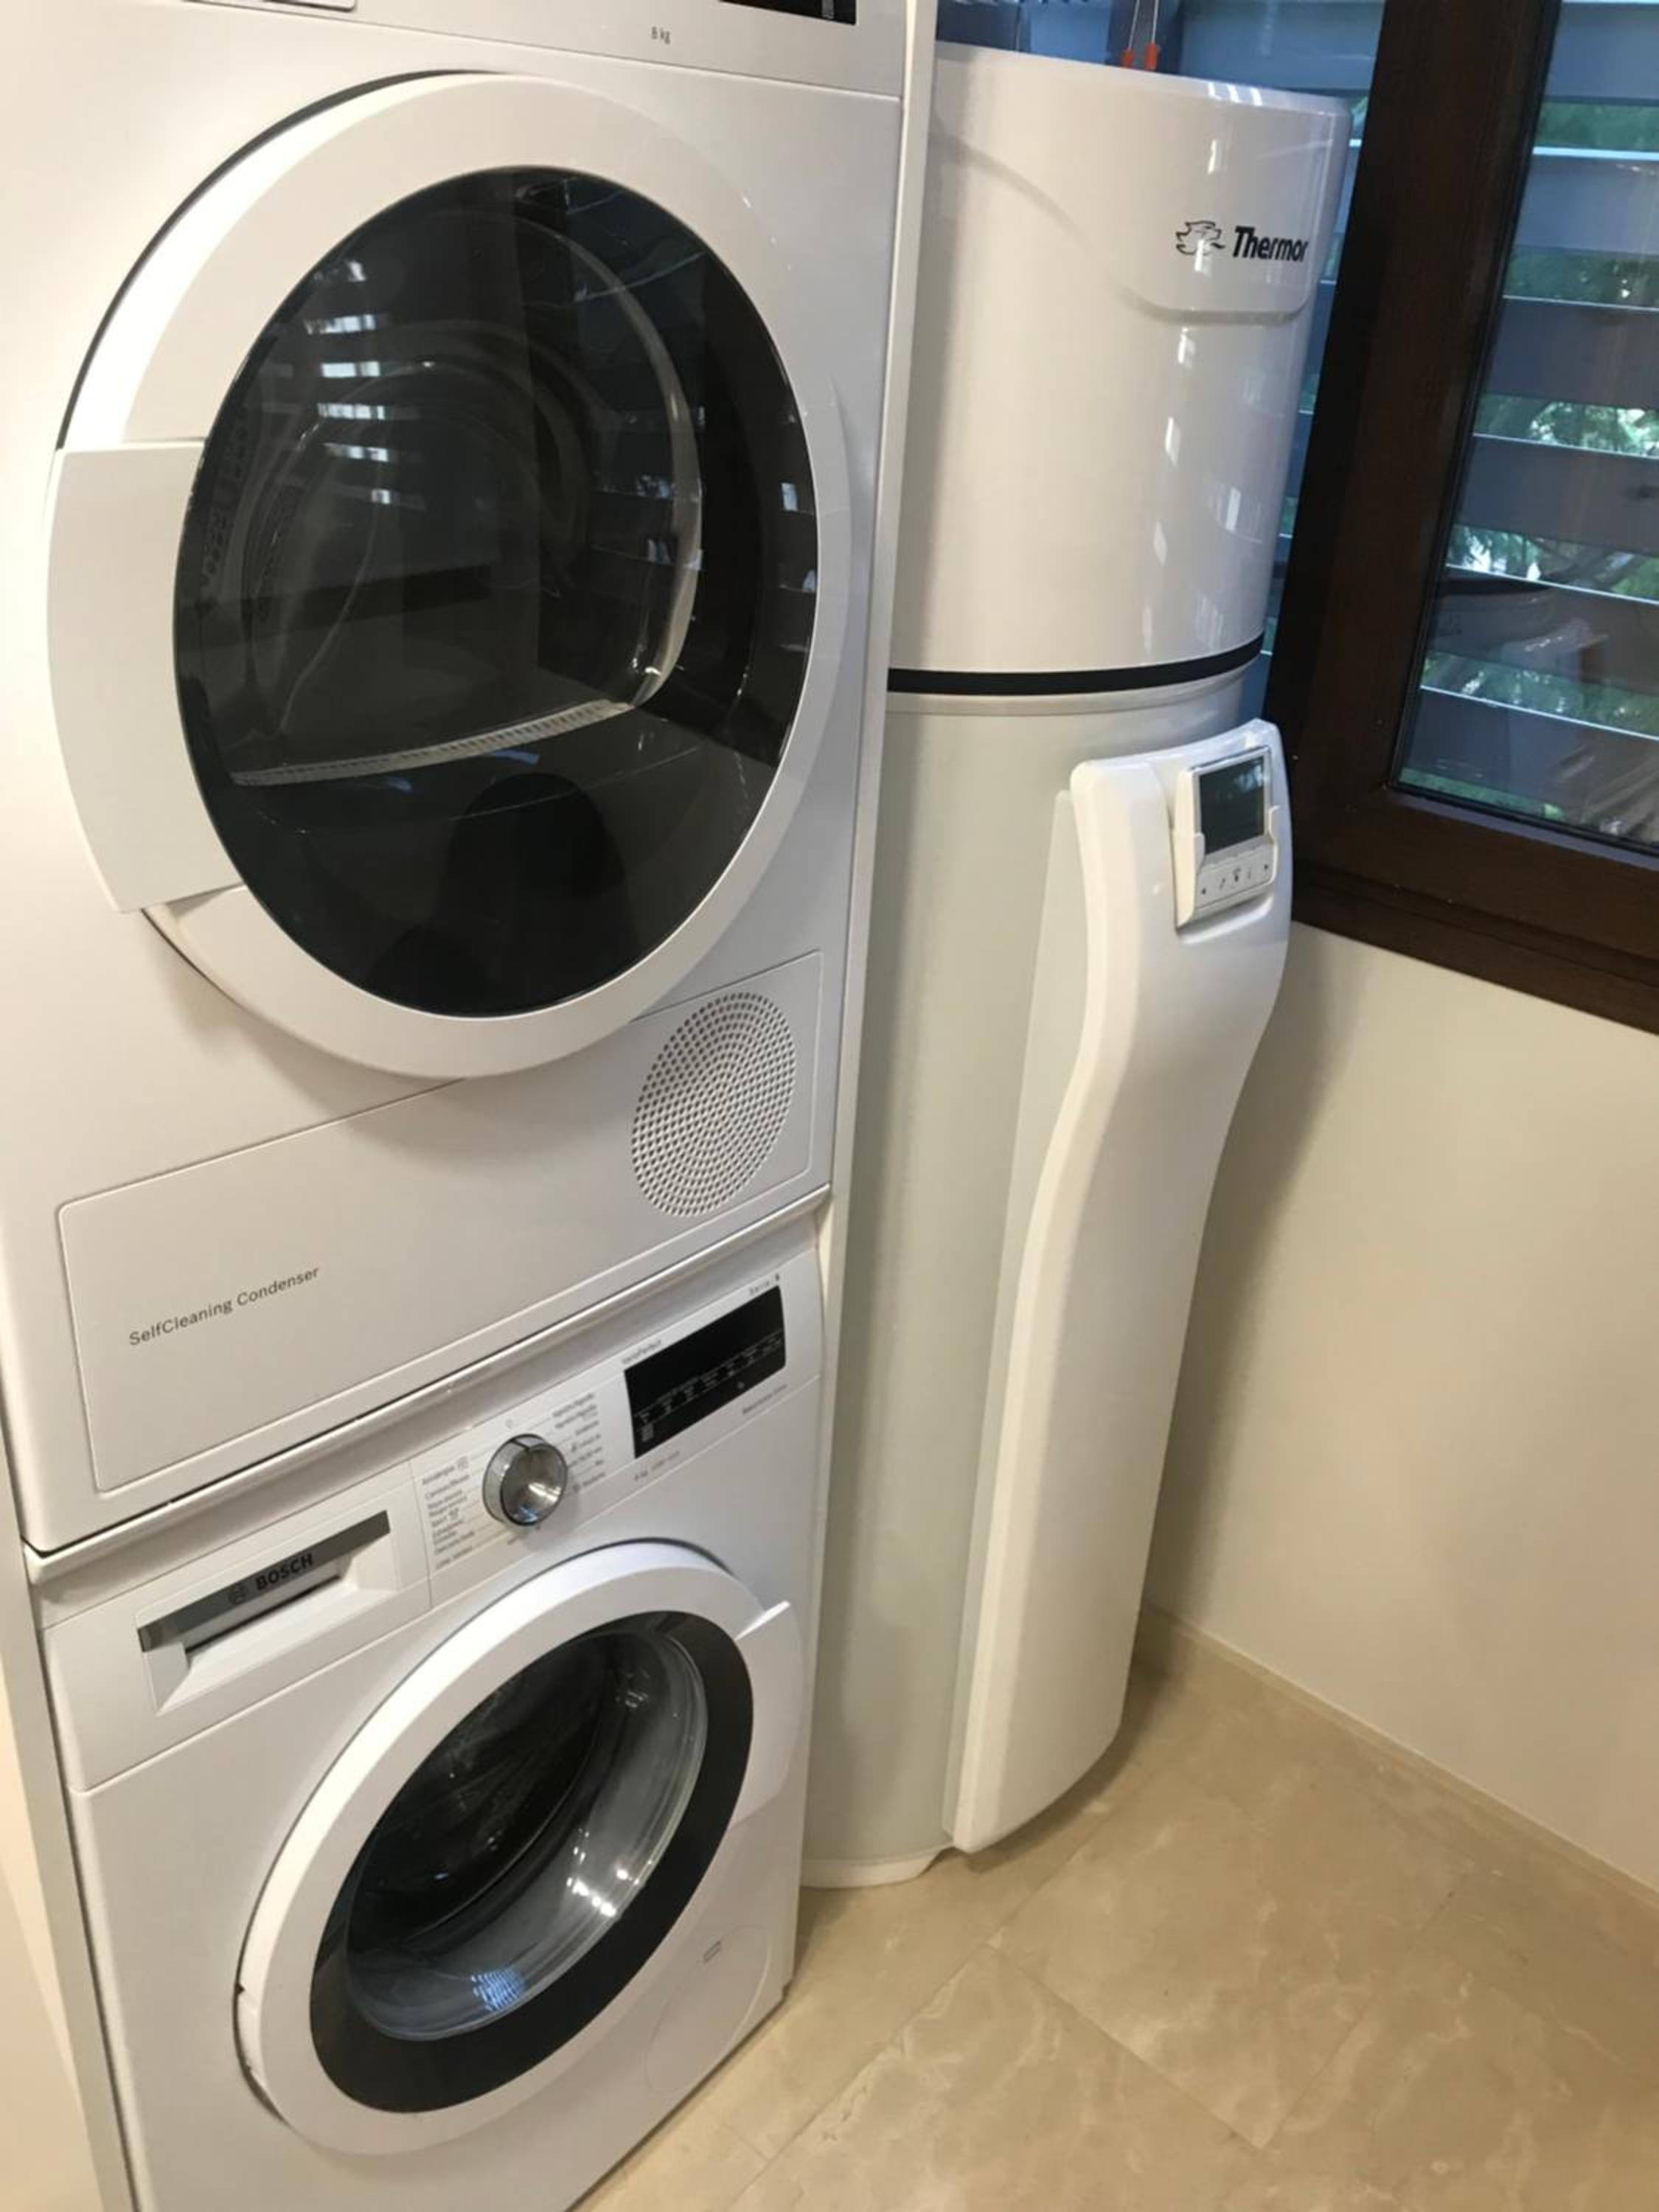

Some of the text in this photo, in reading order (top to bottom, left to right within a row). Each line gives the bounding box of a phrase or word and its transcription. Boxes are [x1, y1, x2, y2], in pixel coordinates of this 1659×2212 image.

[1232, 226, 1309, 262] Thermor
[129, 1267, 319, 1346] SelfCleaning Condenser
[255, 1552, 313, 1590] BOSCH
